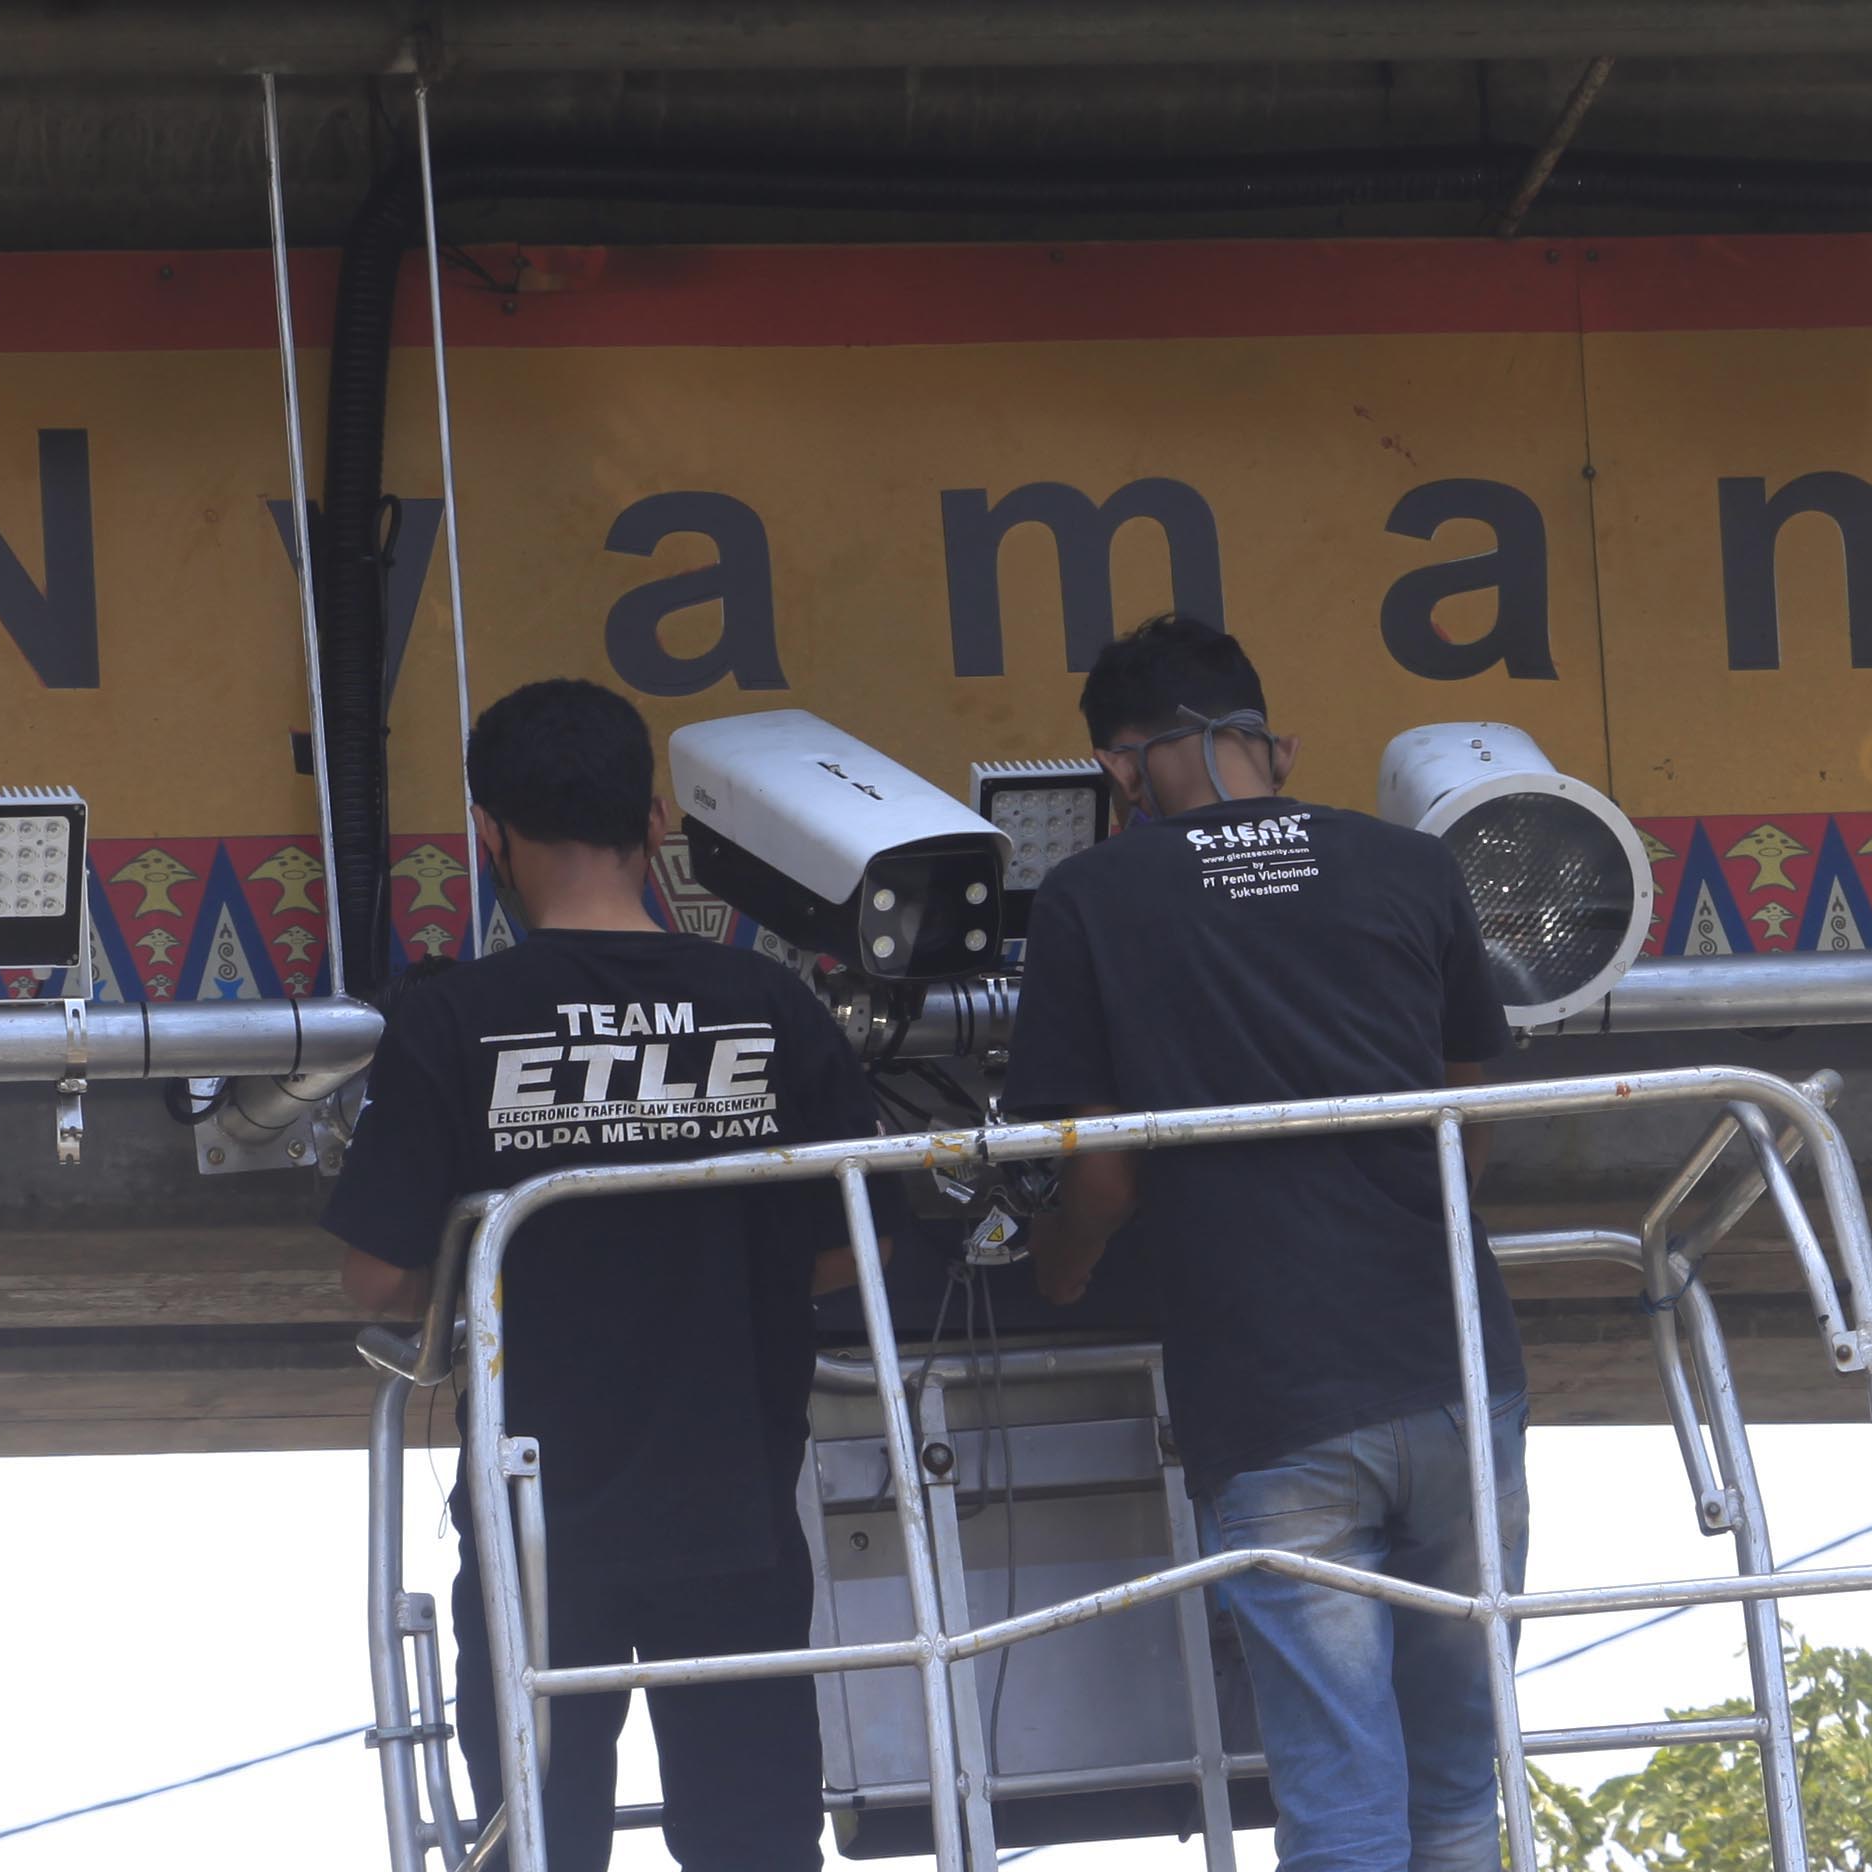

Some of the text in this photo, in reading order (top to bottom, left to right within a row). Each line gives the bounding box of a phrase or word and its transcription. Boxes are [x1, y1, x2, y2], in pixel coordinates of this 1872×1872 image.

[1203, 866, 1320, 889] PT Penta Victorindo
[1252, 861, 1265, 870] by
[556, 1002, 695, 1037] TEAM
[489, 1038, 776, 1110] ETLE
[497, 1097, 768, 1125] ELECTRONIC TRAFFIC LAW ENFORCEMENT
[494, 1114, 779, 1152] POLDA METRO JAYA
